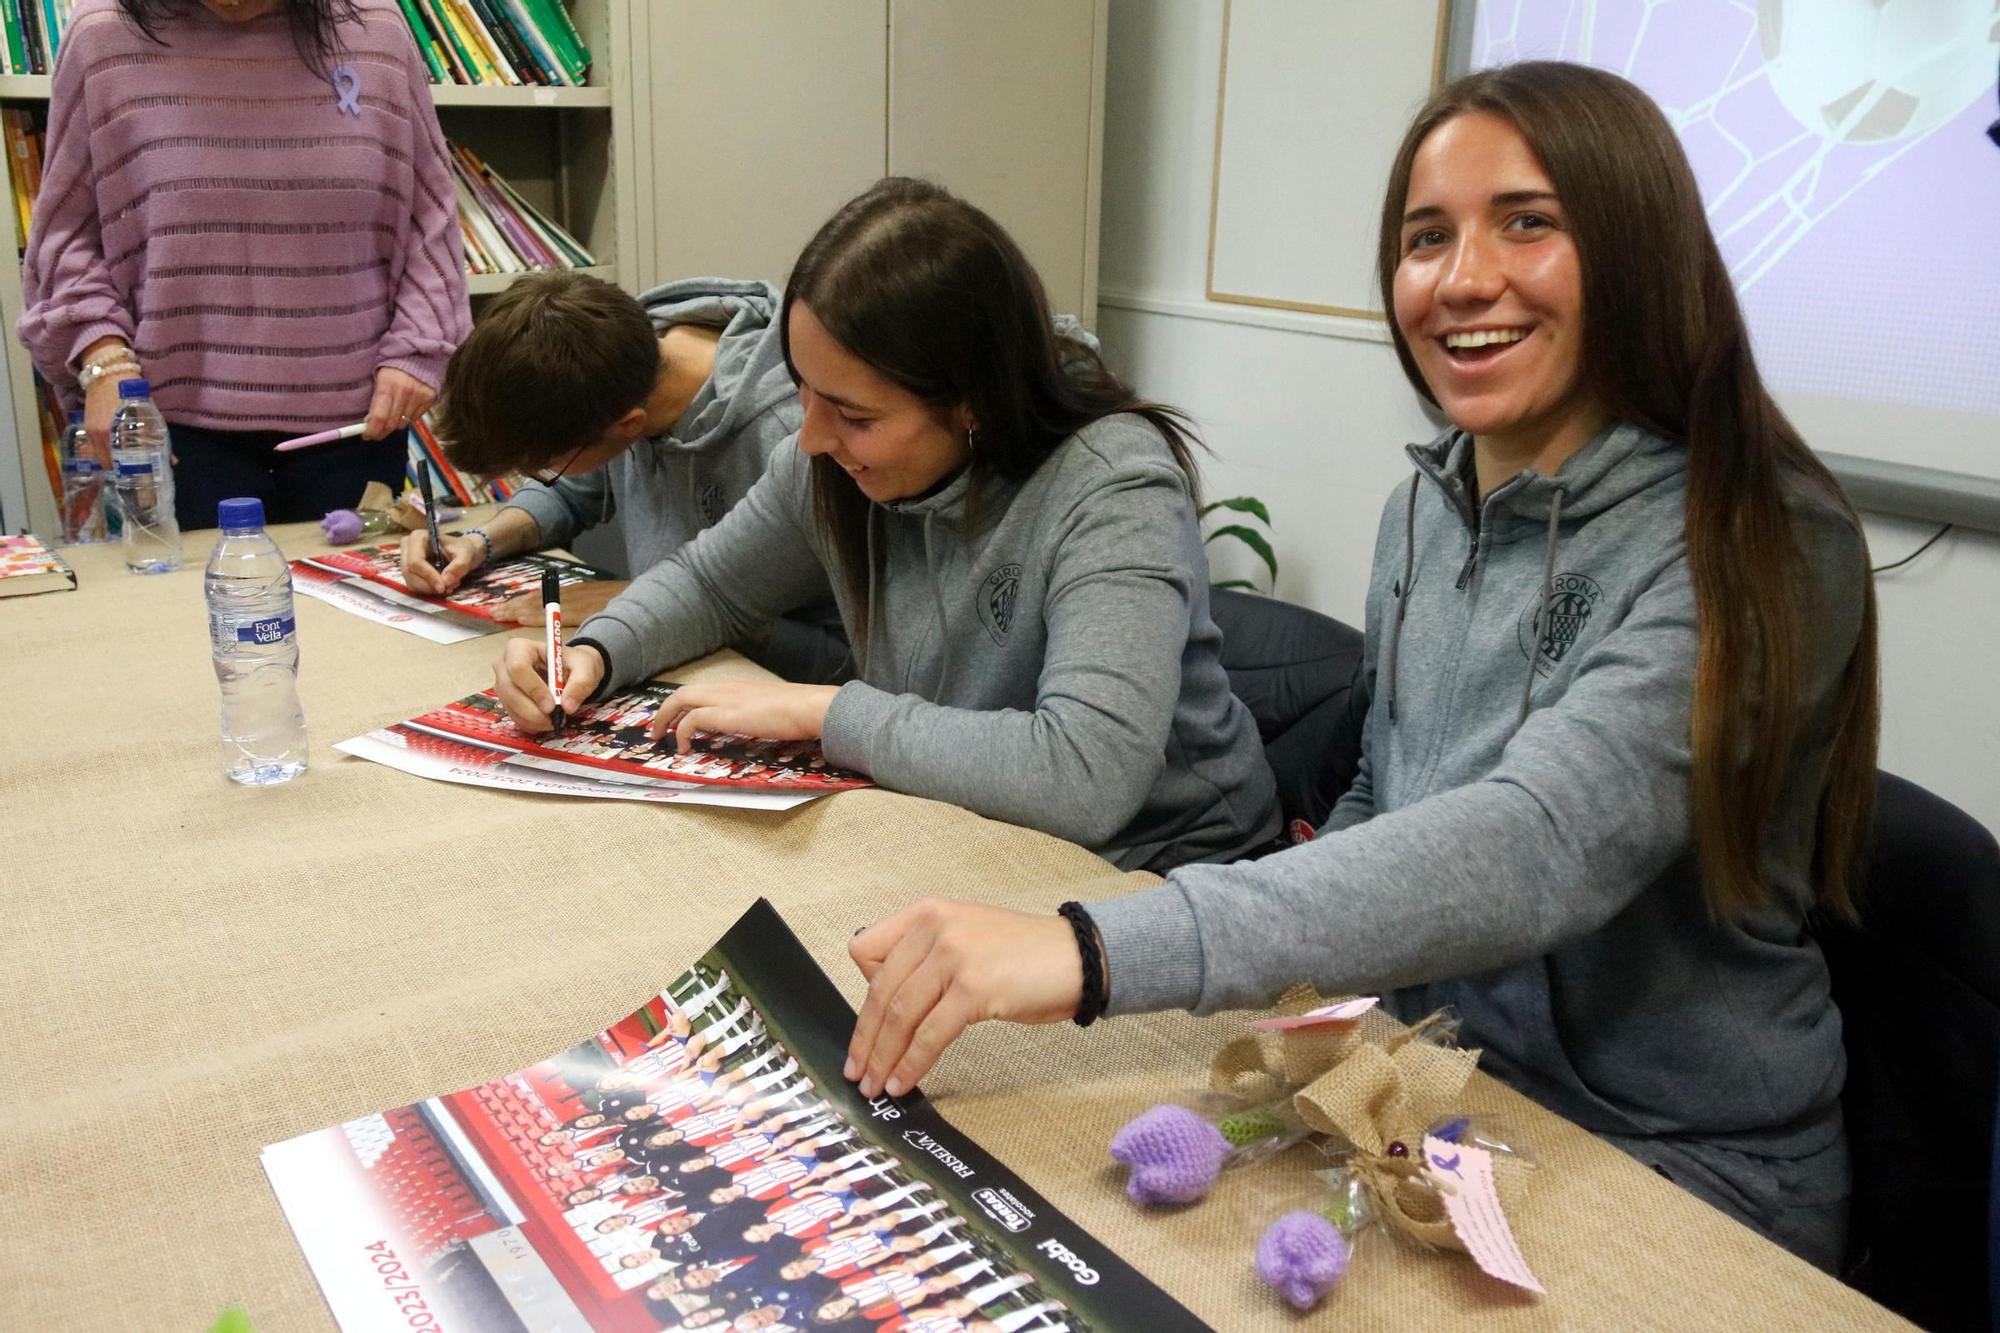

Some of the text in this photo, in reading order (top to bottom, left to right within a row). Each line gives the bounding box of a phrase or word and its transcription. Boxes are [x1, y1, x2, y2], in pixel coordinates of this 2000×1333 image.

[989, 567, 1021, 585] GIRO
[1540, 577, 1600, 606] RONA
[255, 621, 281, 633] Font
[255, 631, 283, 643] Vella
[554, 620, 564, 682] edding 400
[918, 1135, 976, 1179] FRISELVA
[980, 1190, 1025, 1231] TORRAS
[1000, 1188, 1036, 1218] xocolates
[497, 1230, 527, 1260] 1970
[1036, 1238, 1100, 1285] Gosbi
